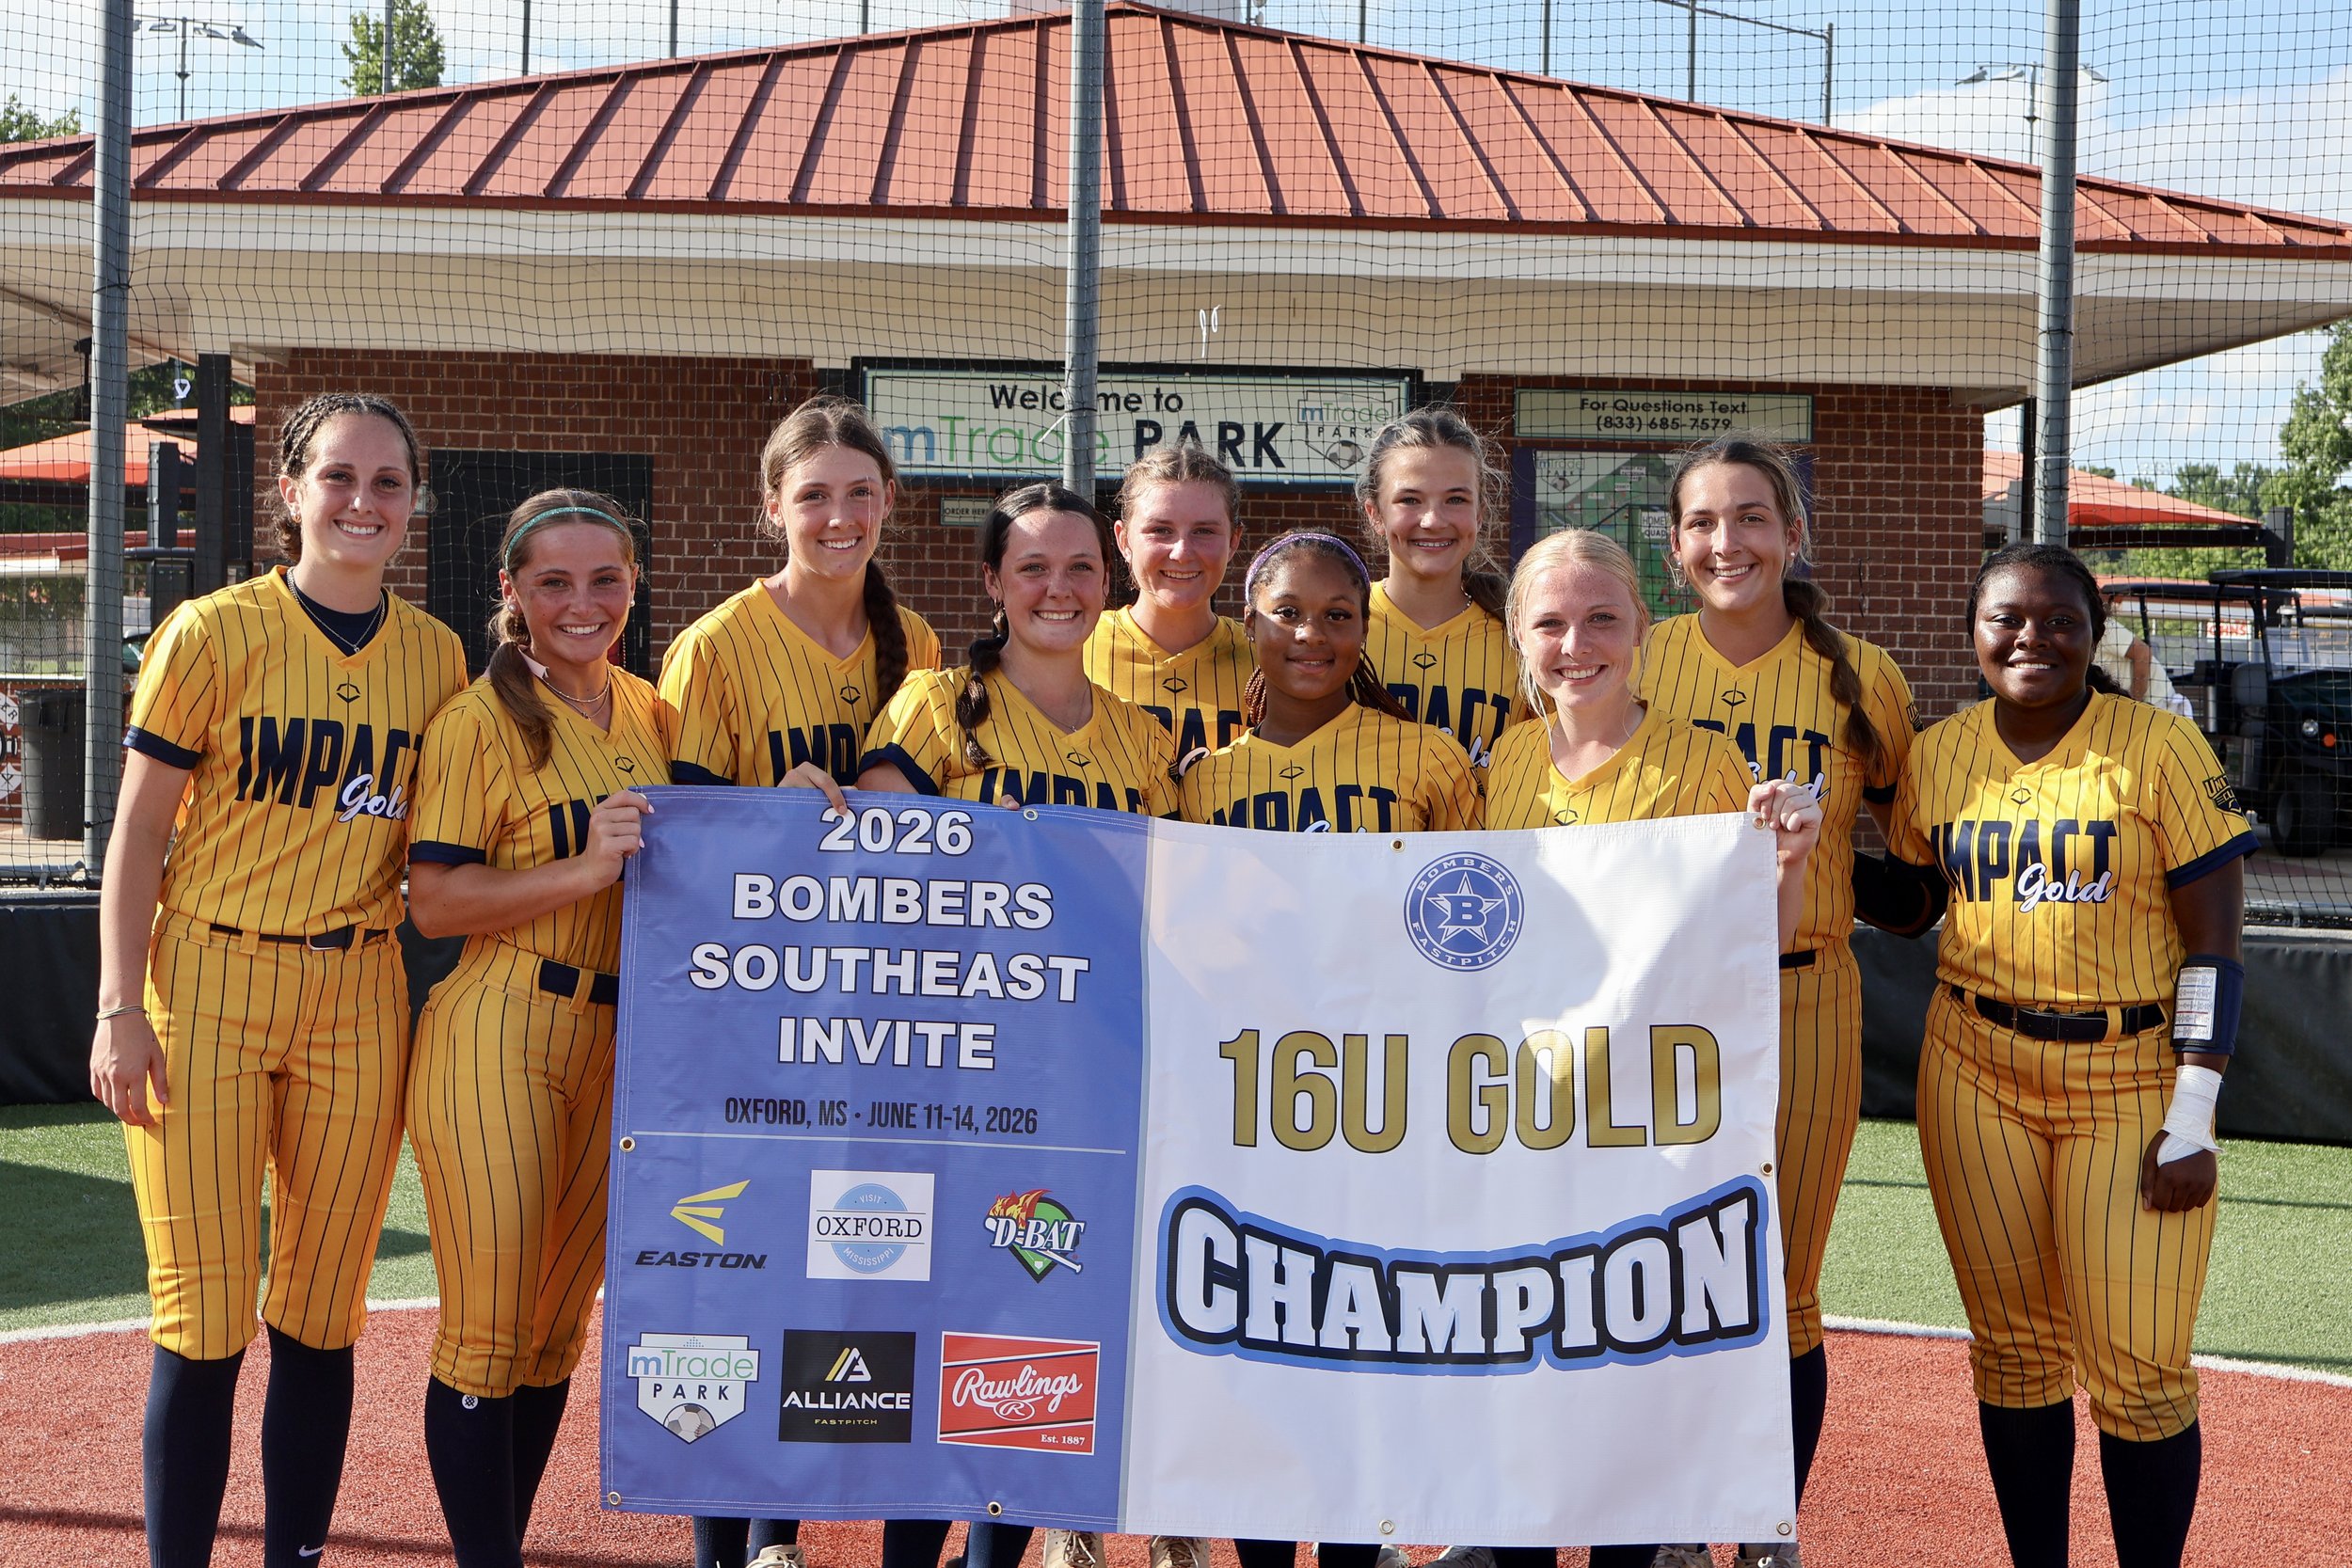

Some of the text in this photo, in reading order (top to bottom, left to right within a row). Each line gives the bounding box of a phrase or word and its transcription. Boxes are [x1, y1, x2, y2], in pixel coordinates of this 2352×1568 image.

[989, 384, 1184, 412] Welcme to
[1301, 403, 1389, 422] mTrade
[1579, 398, 1747, 414] For Questions Text
[1597, 416, 1731, 432] (833) 685-7579
[819, 808, 973, 855] 2026
[1417, 858, 1514, 895] BOMBERS
[2017, 863, 2117, 913] Gold
[733, 874, 1054, 929] BOMBERS
[1412, 920, 1517, 966] FASTPITCH
[689, 942, 1090, 1003] SOUTHEAST
[778, 1017, 995, 1070] INVITE
[1219, 1024, 1721, 1155] 16U GOLD
[724, 1098, 1038, 1135] OXFORD, MS JUNE 11-14, 2026
[859, 1194, 882, 1204] VISIT
[817, 1216, 923, 1238] OXFORD
[635, 1251, 767, 1269] EASTON
[843, 1247, 895, 1266] MISSISSIPPI
[1168, 1187, 1759, 1364] CHAMPION
[631, 1350, 754, 1379] mTrade
[653, 1384, 729, 1400] PARK
[782, 1391, 911, 1409] ALLIANCE
[952, 1365, 1083, 1413] Rawlings
[1041, 1434, 1086, 1446] Est. 1887
